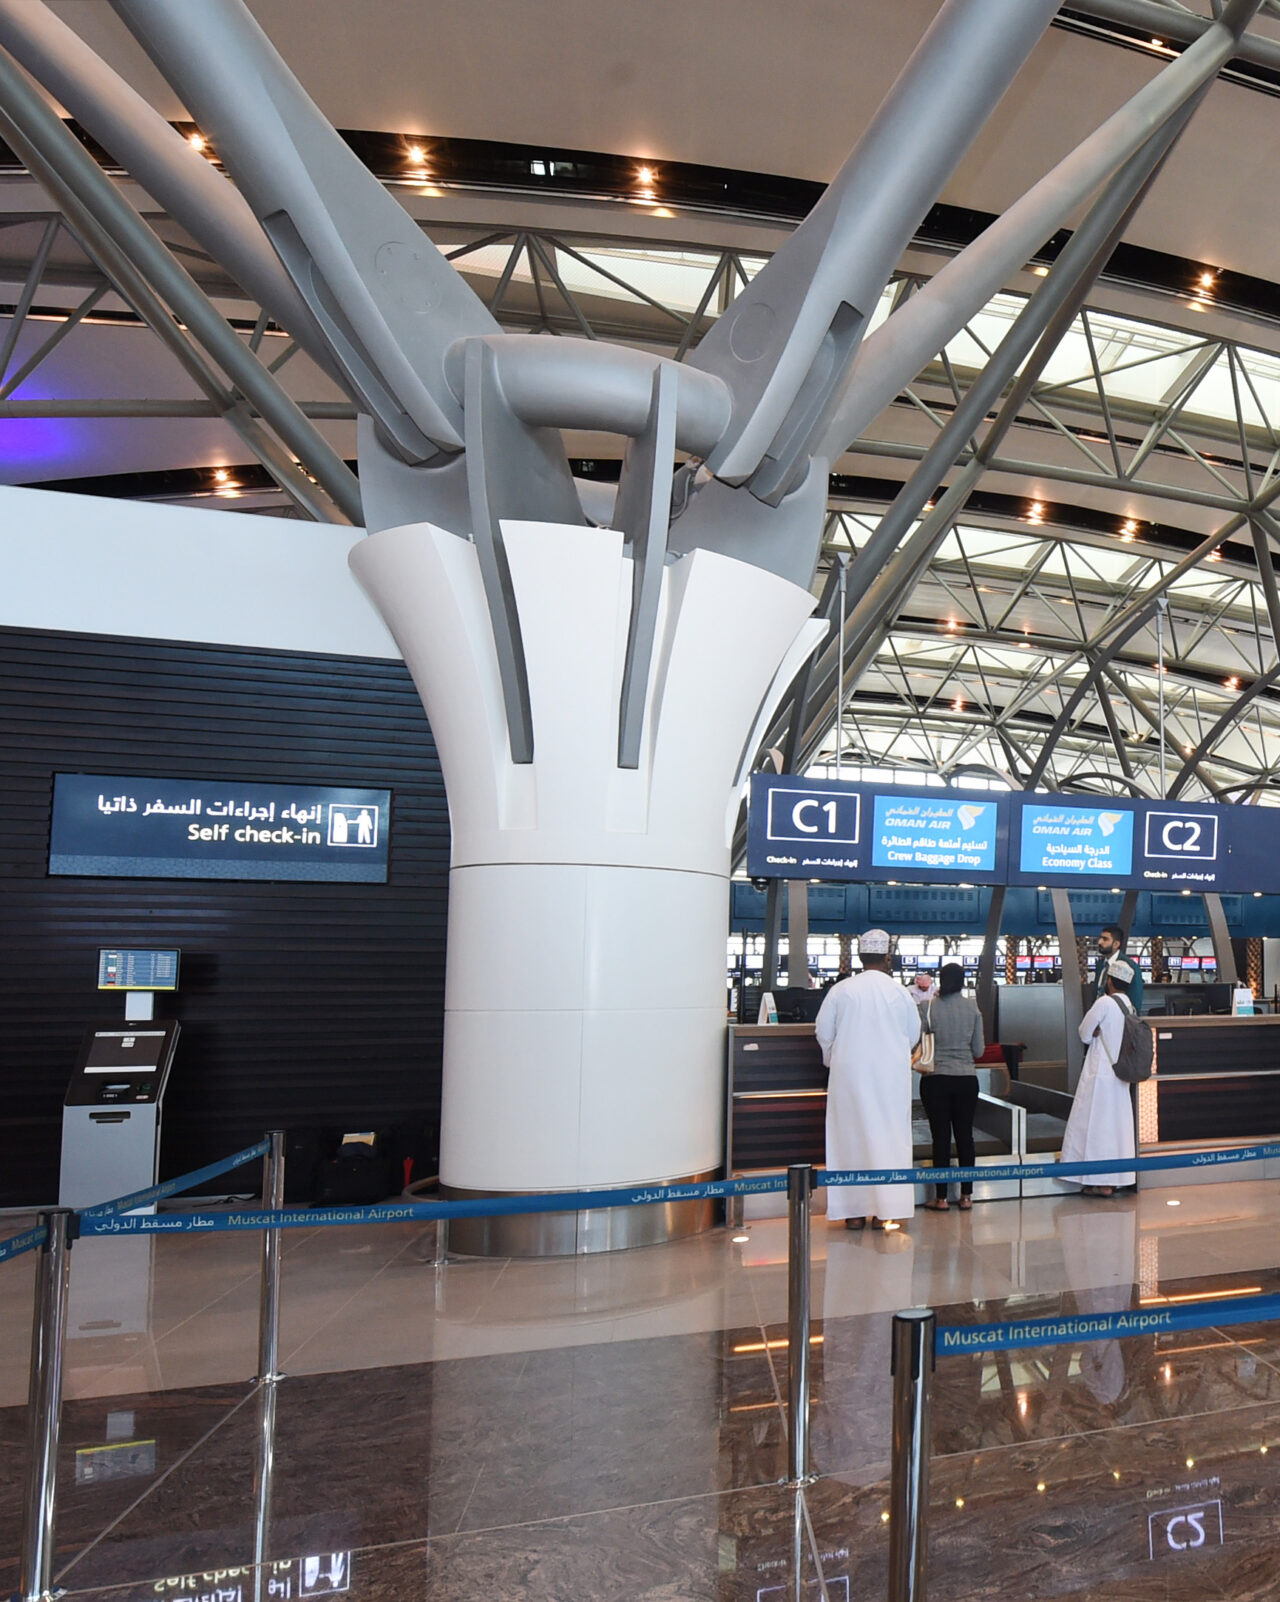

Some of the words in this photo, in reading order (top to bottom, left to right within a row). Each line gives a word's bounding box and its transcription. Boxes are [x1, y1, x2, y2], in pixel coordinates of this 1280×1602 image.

[97, 795, 137, 814] ذاتيا
[142, 798, 201, 817] السفر
[206, 802, 275, 822] إجراءات
[281, 803, 322, 824] إنهاء
[792, 799, 837, 834] C1
[885, 818, 926, 828] OMAN
[928, 820, 951, 830] AIR
[1032, 825, 1070, 835] OMAN
[1072, 827, 1092, 836] AIR
[188, 823, 229, 841] Self
[234, 825, 321, 844] check-in
[1162, 820, 1201, 851] C2
[881, 835, 912, 847] الطائرة
[913, 837, 936, 848] طاقم
[938, 837, 962, 849] أمتعة
[962, 840, 988, 851] تسليم
[1046, 843, 1082, 855] السياحية
[1084, 844, 1110, 857] الدرجة
[887, 851, 913, 861] Crew
[915, 852, 955, 865] Baggage
[957, 854, 981, 867] Drop
[1042, 857, 1086, 871] Economy
[1088, 857, 1112, 869] Class
[824, 1173, 854, 1184] الدولي
[855, 1172, 886, 1182] مسقط
[887, 1171, 907, 1183] مطار
[915, 1171, 949, 1180] Muscat
[951, 1167, 1010, 1179] International
[1011, 1166, 1044, 1177] Airport
[701, 1185, 725, 1198] مطار
[734, 1180, 771, 1192] Muscat
[631, 1189, 664, 1203] الدولي
[666, 1187, 699, 1199] مسقط
[186, 1216, 215, 1229] مطار
[228, 1214, 277, 1227] Muscat
[280, 1209, 365, 1223] International
[368, 1205, 414, 1223] Airport
[94, 1218, 136, 1232] الدولي
[139, 1217, 182, 1230] مسقط
[944, 1327, 1004, 1347] Muscat
[1008, 1315, 1113, 1340] International
[1116, 1311, 1171, 1331] Airport
